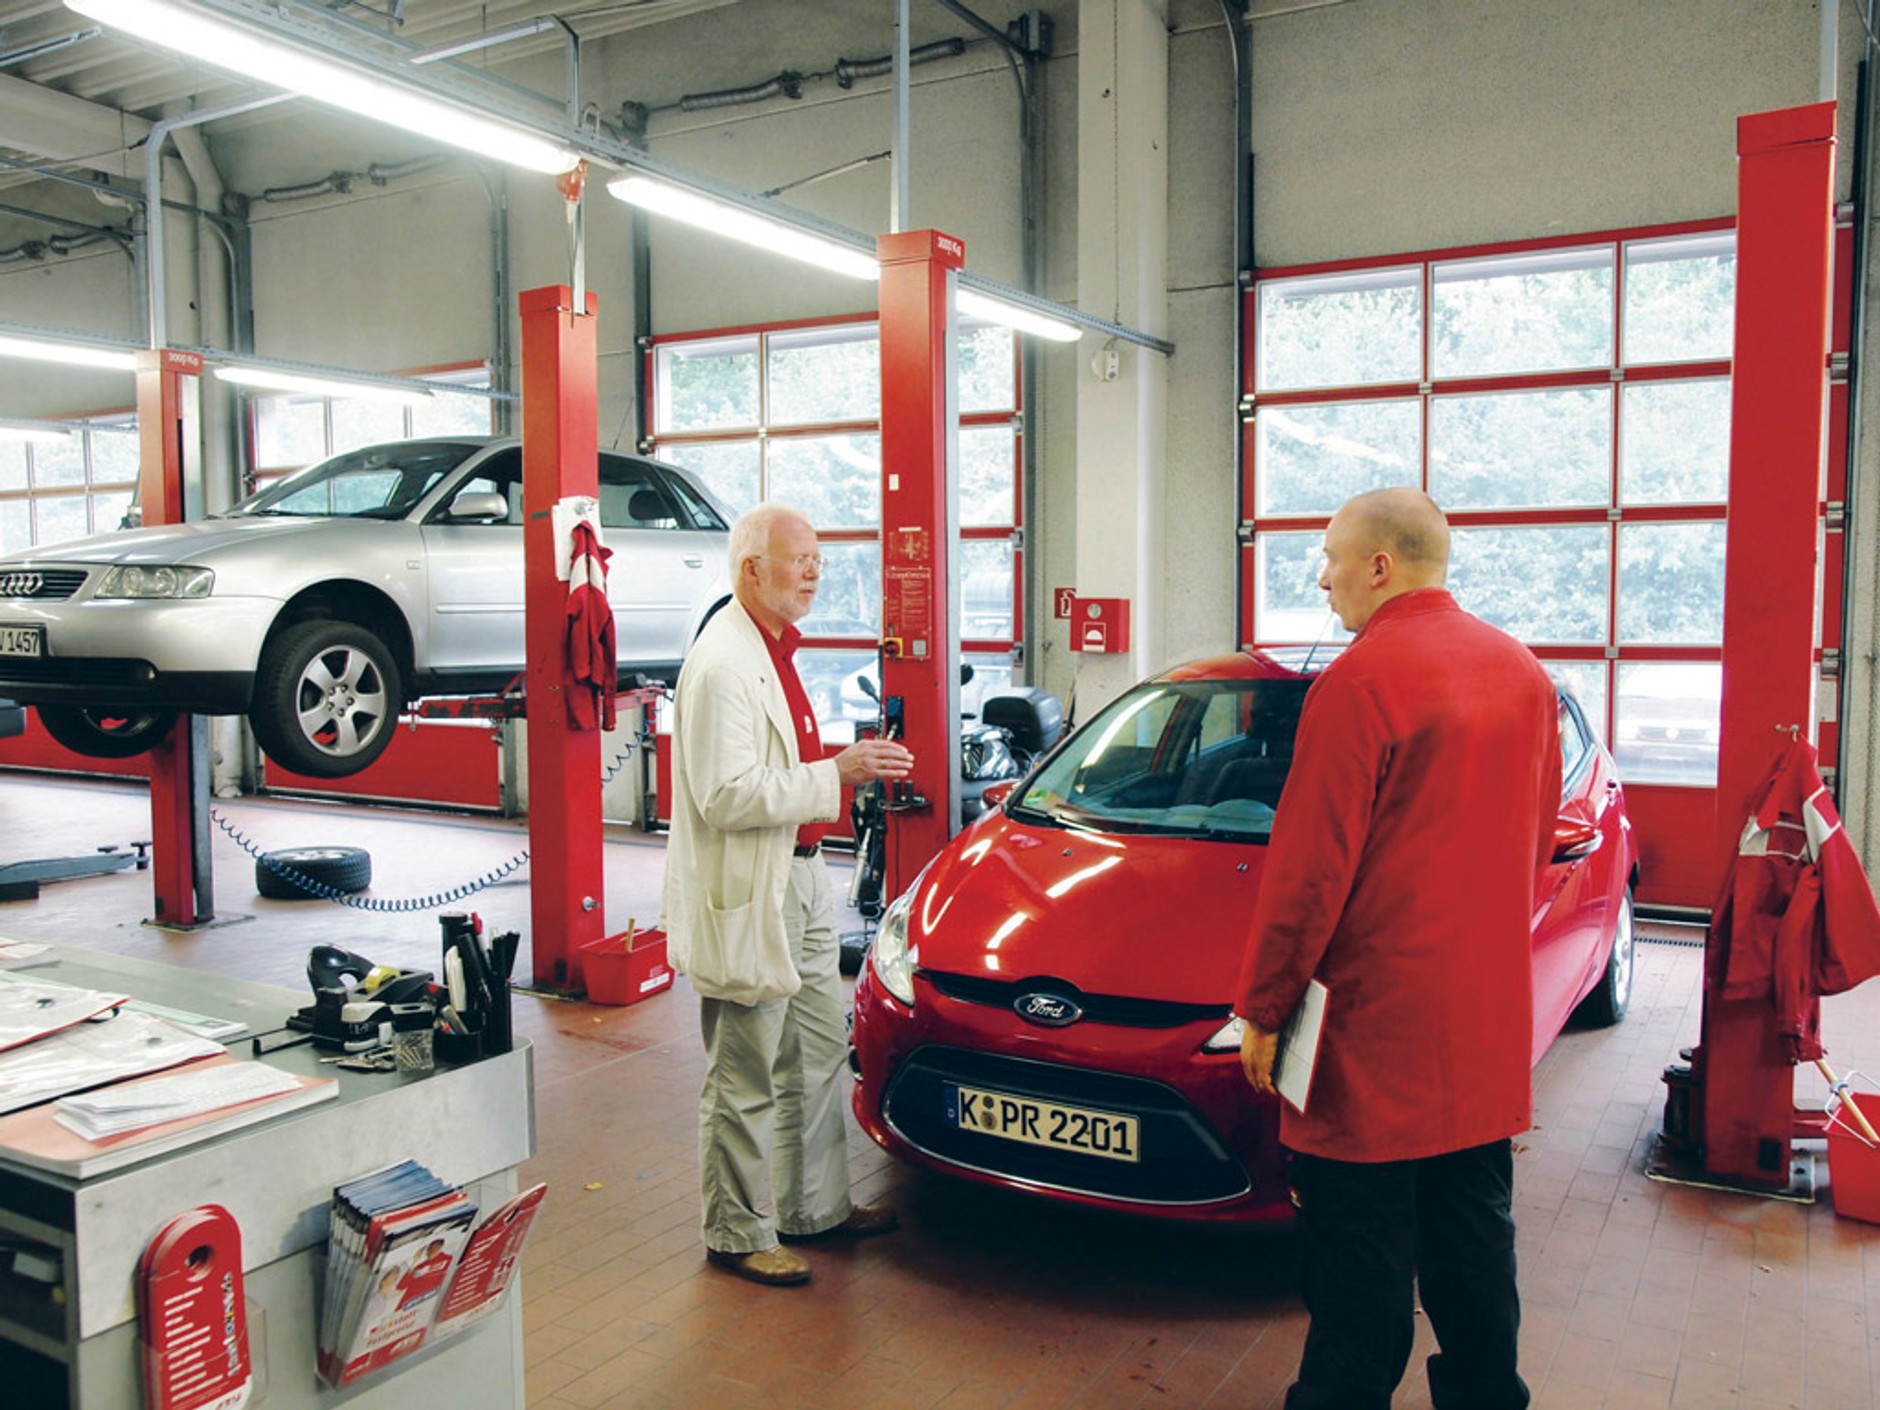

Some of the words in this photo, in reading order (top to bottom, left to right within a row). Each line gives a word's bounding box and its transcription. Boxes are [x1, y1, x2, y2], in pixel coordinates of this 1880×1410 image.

[8, 631, 38, 653] 1457
[1026, 997, 1064, 1018] Ford
[960, 1091, 978, 1126] K
[1001, 1099, 1040, 1140] PR
[1050, 1110, 1132, 1156] 2201
